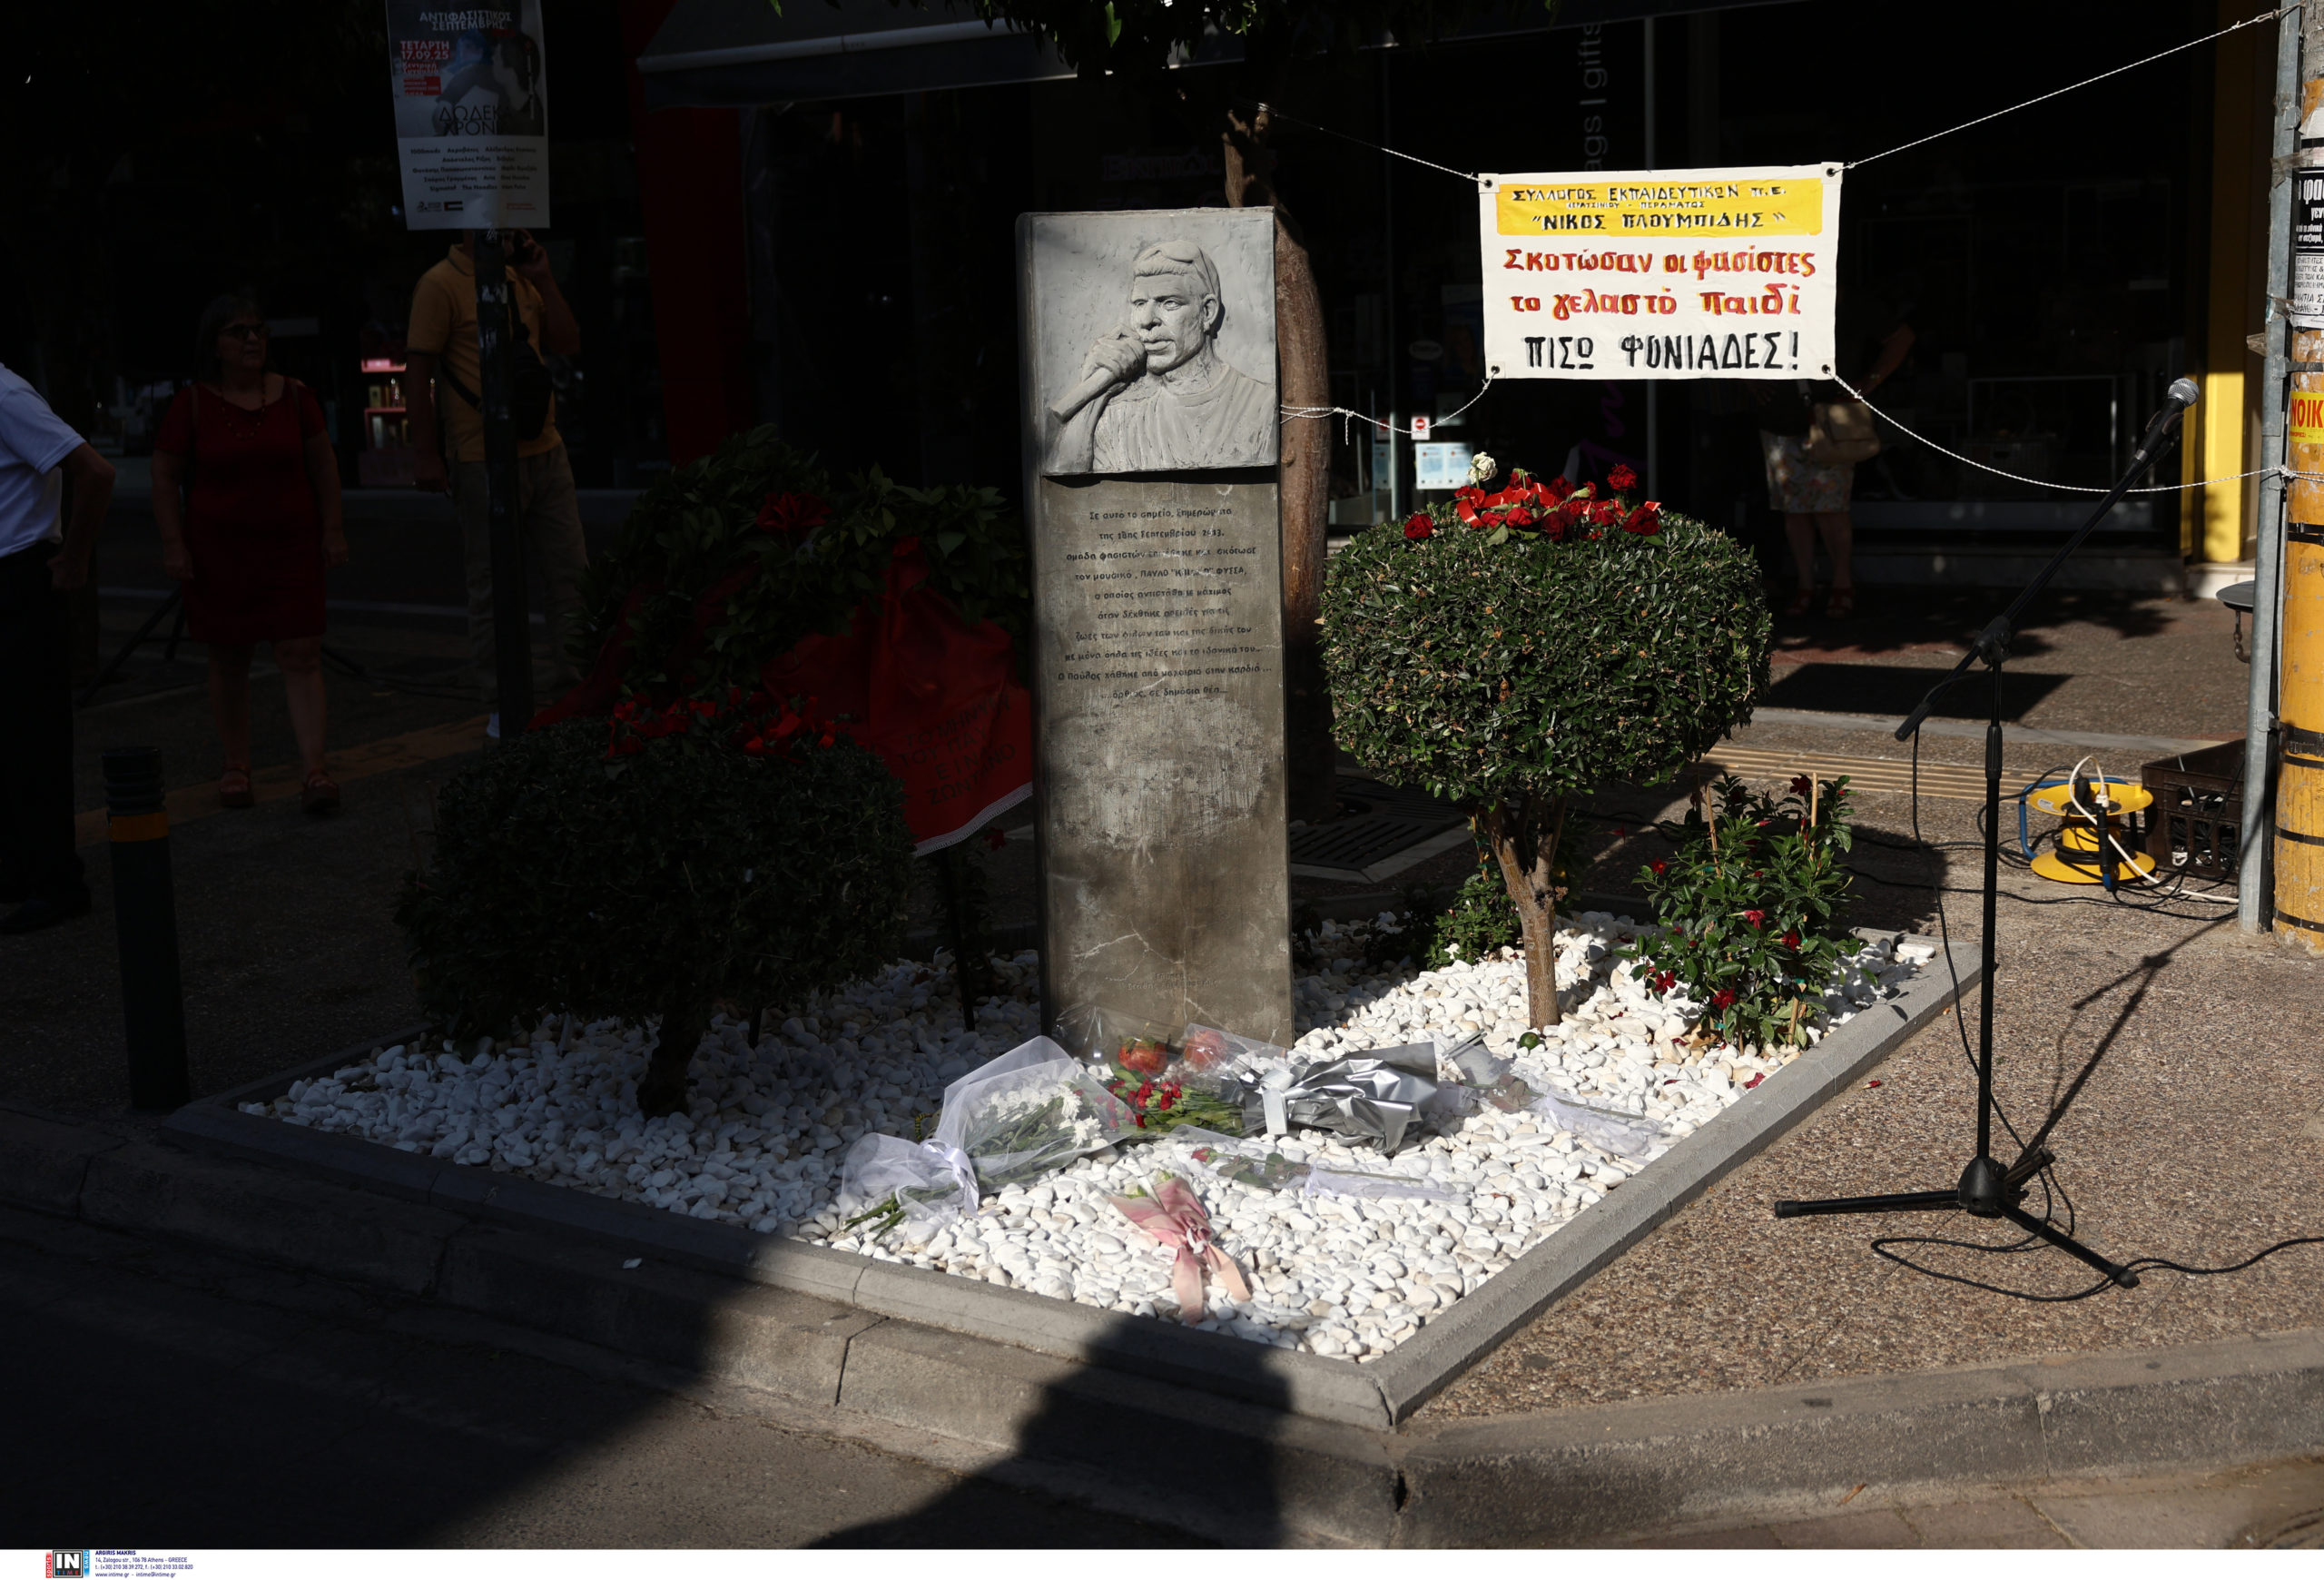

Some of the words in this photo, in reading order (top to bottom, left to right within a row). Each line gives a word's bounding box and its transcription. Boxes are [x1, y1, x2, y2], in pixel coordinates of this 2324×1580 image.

[419, 9, 512, 22] ΑΝΤΙΦΑΣΙΣΤΙΚΟΣ
[432, 19, 505, 31] ΣΕΠΤΕΜΒΡΗΣ
[400, 41, 449, 50] ΤΕΤΑΡΤΗ
[401, 50, 448, 60] 17.09.25
[1512, 188, 1597, 202] ΣΥΛΛΟΓΟΣ
[1609, 184, 1739, 201] ΕΚΠΑΙΔΕΥΤΙΚΩΝ
[2303, 179, 2324, 205] φα
[1640, 201, 1705, 209] ΠΕΡΑΜΑΤΟΣ
[1503, 248, 1653, 273] Σκοτώσαν
[1663, 253, 1688, 273] οι
[1692, 244, 1817, 281] φασίστες
[1509, 295, 1541, 312] το
[1552, 286, 1678, 321] γελαστό
[1697, 282, 1801, 316] παιδί
[1521, 336, 1595, 370] ΠΙΣΩ
[1620, 331, 1799, 371] ΦΟΝΙΑΔΕΣ!
[1089, 511, 1099, 520] Σε
[1103, 509, 1125, 518] αυτό
[1140, 528, 1196, 539] Σεπτεμβρίου
[1066, 551, 1097, 561] ομάδα
[1099, 549, 1146, 563] φασιστών
[1216, 546, 1256, 556] σκότωσε
[1140, 569, 1169, 578] ΠΑΥΛΟ
[1104, 590, 1134, 600] οποίος
[1098, 610, 1119, 620] όταν
[1122, 609, 1161, 618] δέχθηκε
[1078, 650, 1101, 661] μόνα
[1104, 650, 1128, 659] όπλα
[1058, 673, 1065, 681] Ο
[1068, 671, 1101, 682] Παύλος
[1104, 670, 1138, 679] χάθηκε
[1141, 668, 1158, 677] από
[1163, 686, 1200, 696] δημόσια
